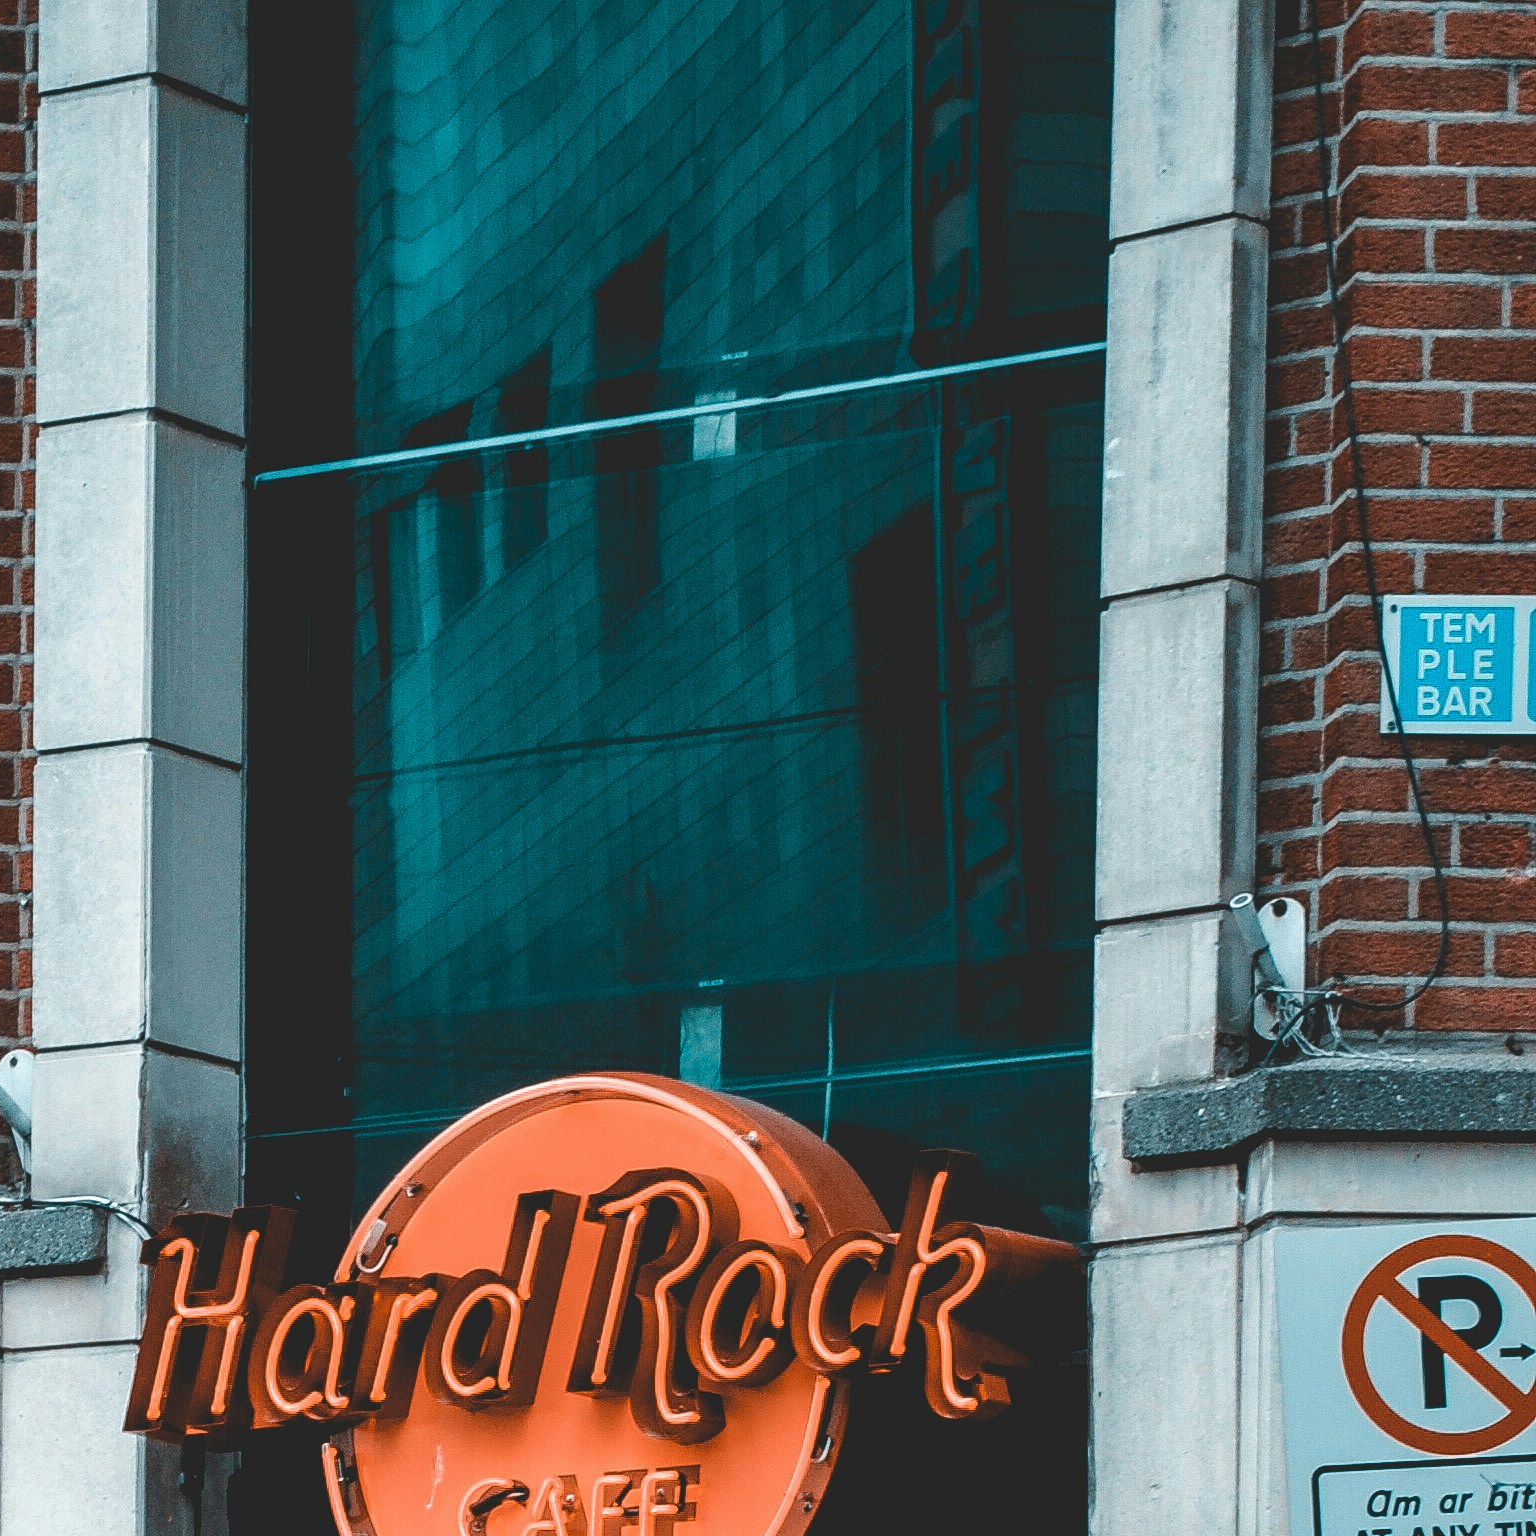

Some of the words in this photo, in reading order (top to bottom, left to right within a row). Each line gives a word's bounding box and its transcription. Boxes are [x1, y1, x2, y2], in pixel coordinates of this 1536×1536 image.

[1419, 612, 1496, 644] TEM
[1417, 649, 1495, 681] PLE
[1416, 686, 1493, 716] BAR
[124, 1188, 581, 1450] Hard
[567, 1149, 1011, 1446] Rock
[1439, 1492, 1473, 1513] ar
[1487, 1483, 1536, 1511] bit
